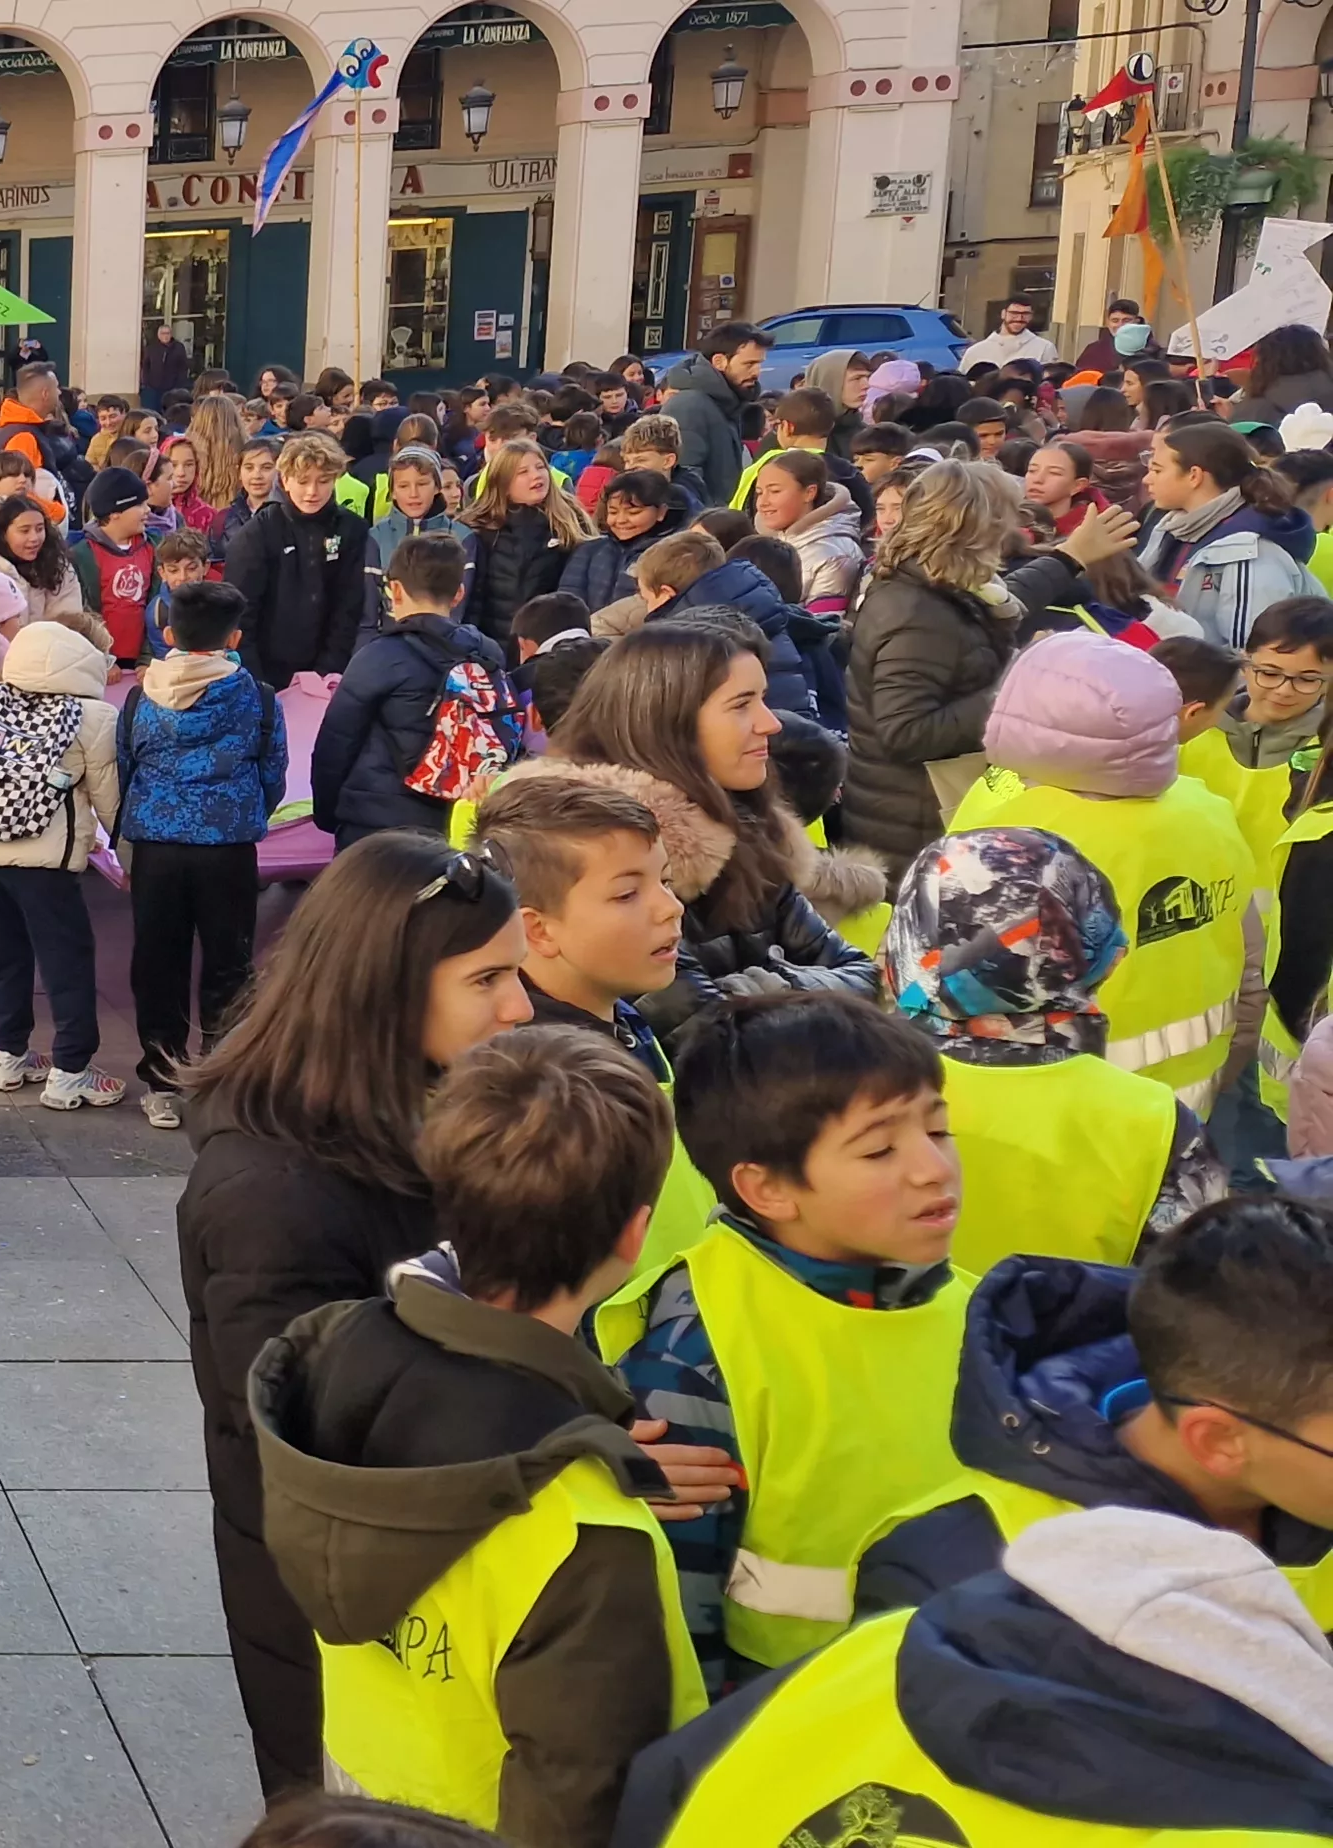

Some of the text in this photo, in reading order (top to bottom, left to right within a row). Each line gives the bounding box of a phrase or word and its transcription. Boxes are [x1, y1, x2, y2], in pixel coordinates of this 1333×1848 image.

[726, 11, 749, 24] 1871
[463, 26, 475, 44] LA
[478, 24, 530, 43] CONFIANZA
[220, 41, 233, 60] LA
[234, 40, 287, 59] CONFIANZA
